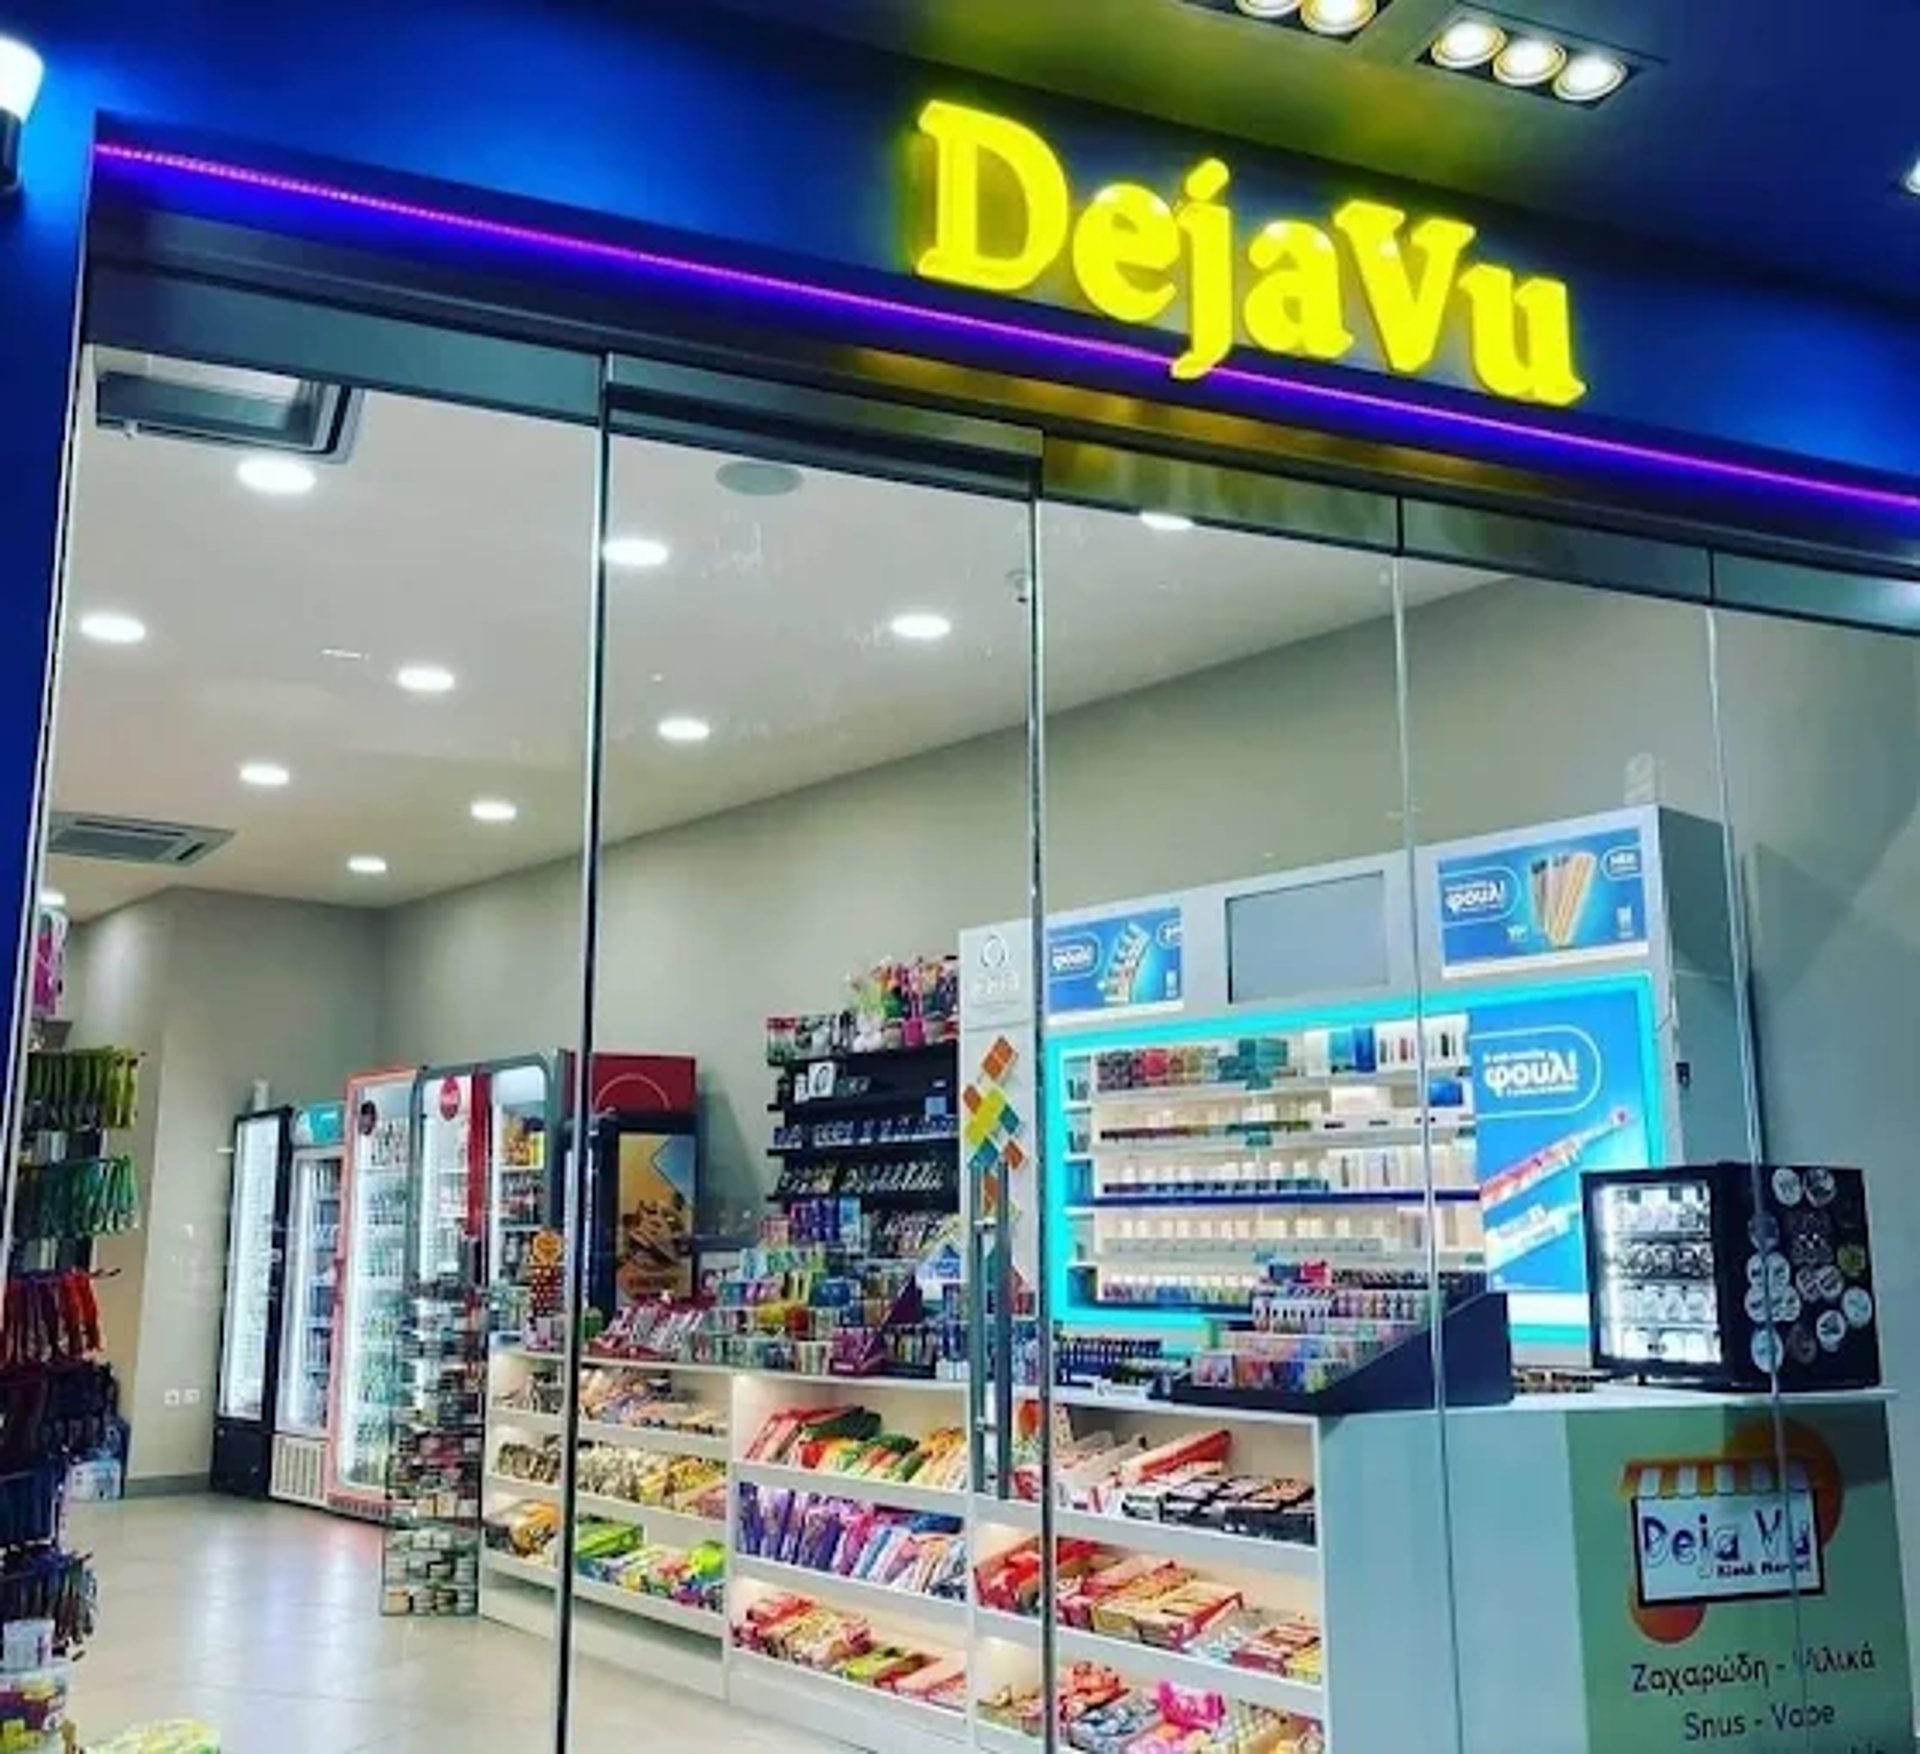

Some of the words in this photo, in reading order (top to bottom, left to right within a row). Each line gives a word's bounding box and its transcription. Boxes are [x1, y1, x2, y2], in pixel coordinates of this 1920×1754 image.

[1760, 1559, 1811, 1575] Maret
[1632, 1655, 1768, 1695] Ζαχαρώδη
[1685, 1711, 1745, 1740] Snus
[1770, 1703, 1835, 1732] Vape
